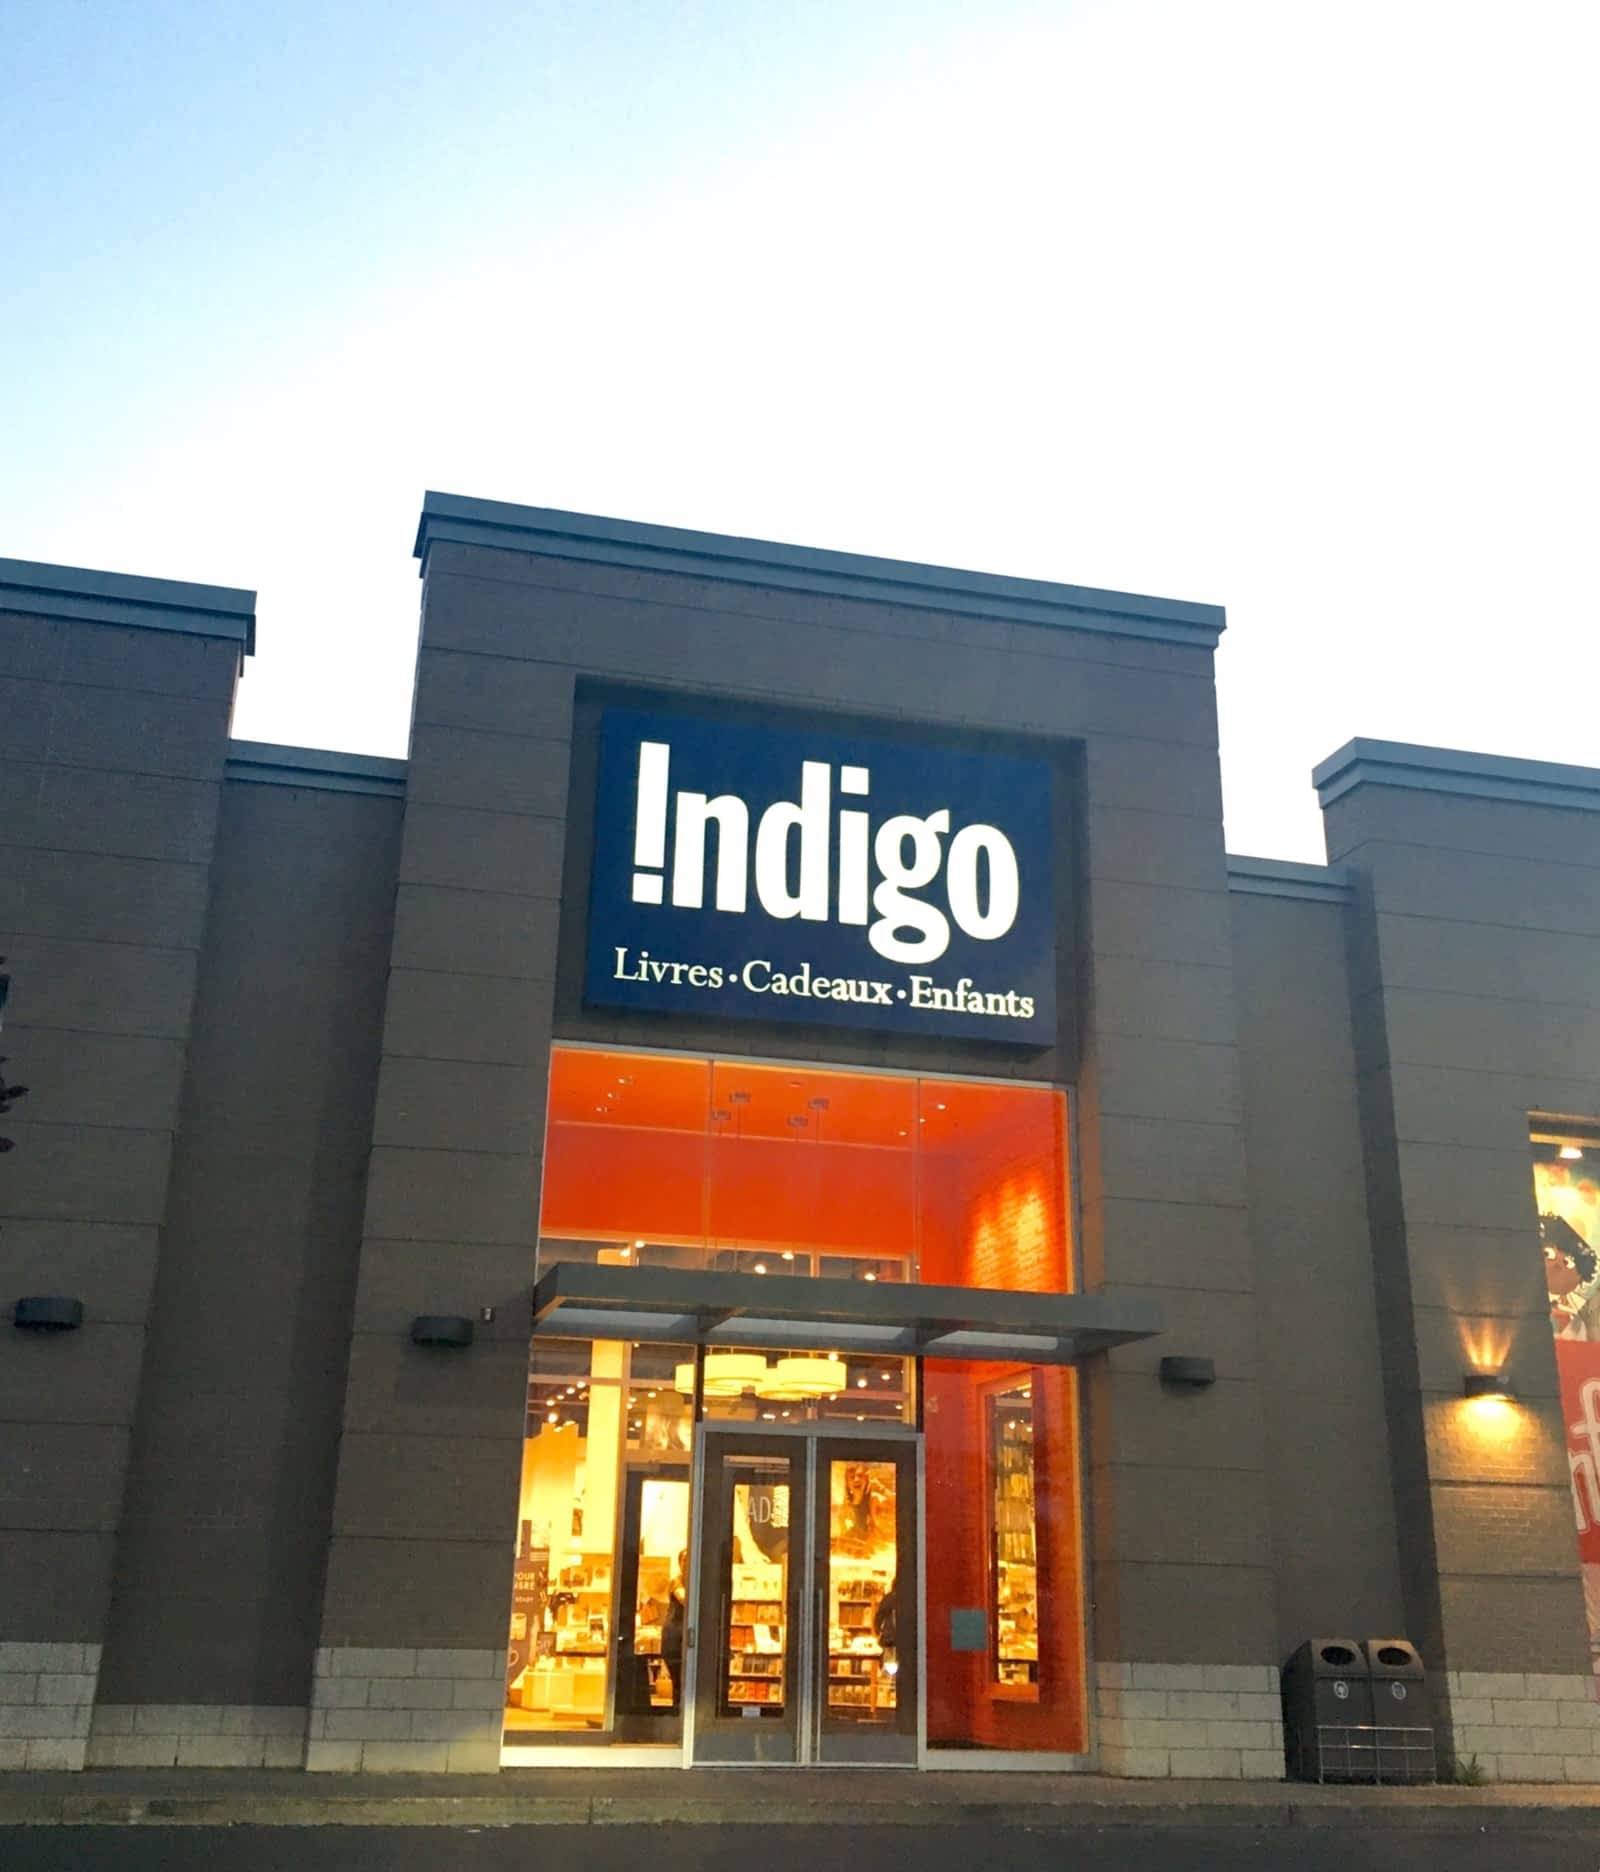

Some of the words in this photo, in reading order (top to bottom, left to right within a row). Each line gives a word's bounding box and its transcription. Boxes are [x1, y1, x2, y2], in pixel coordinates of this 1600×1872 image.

[613, 947, 723, 989] Livres
[742, 959, 894, 1005] Cadeaux
[909, 975, 1035, 1019] Enfants
